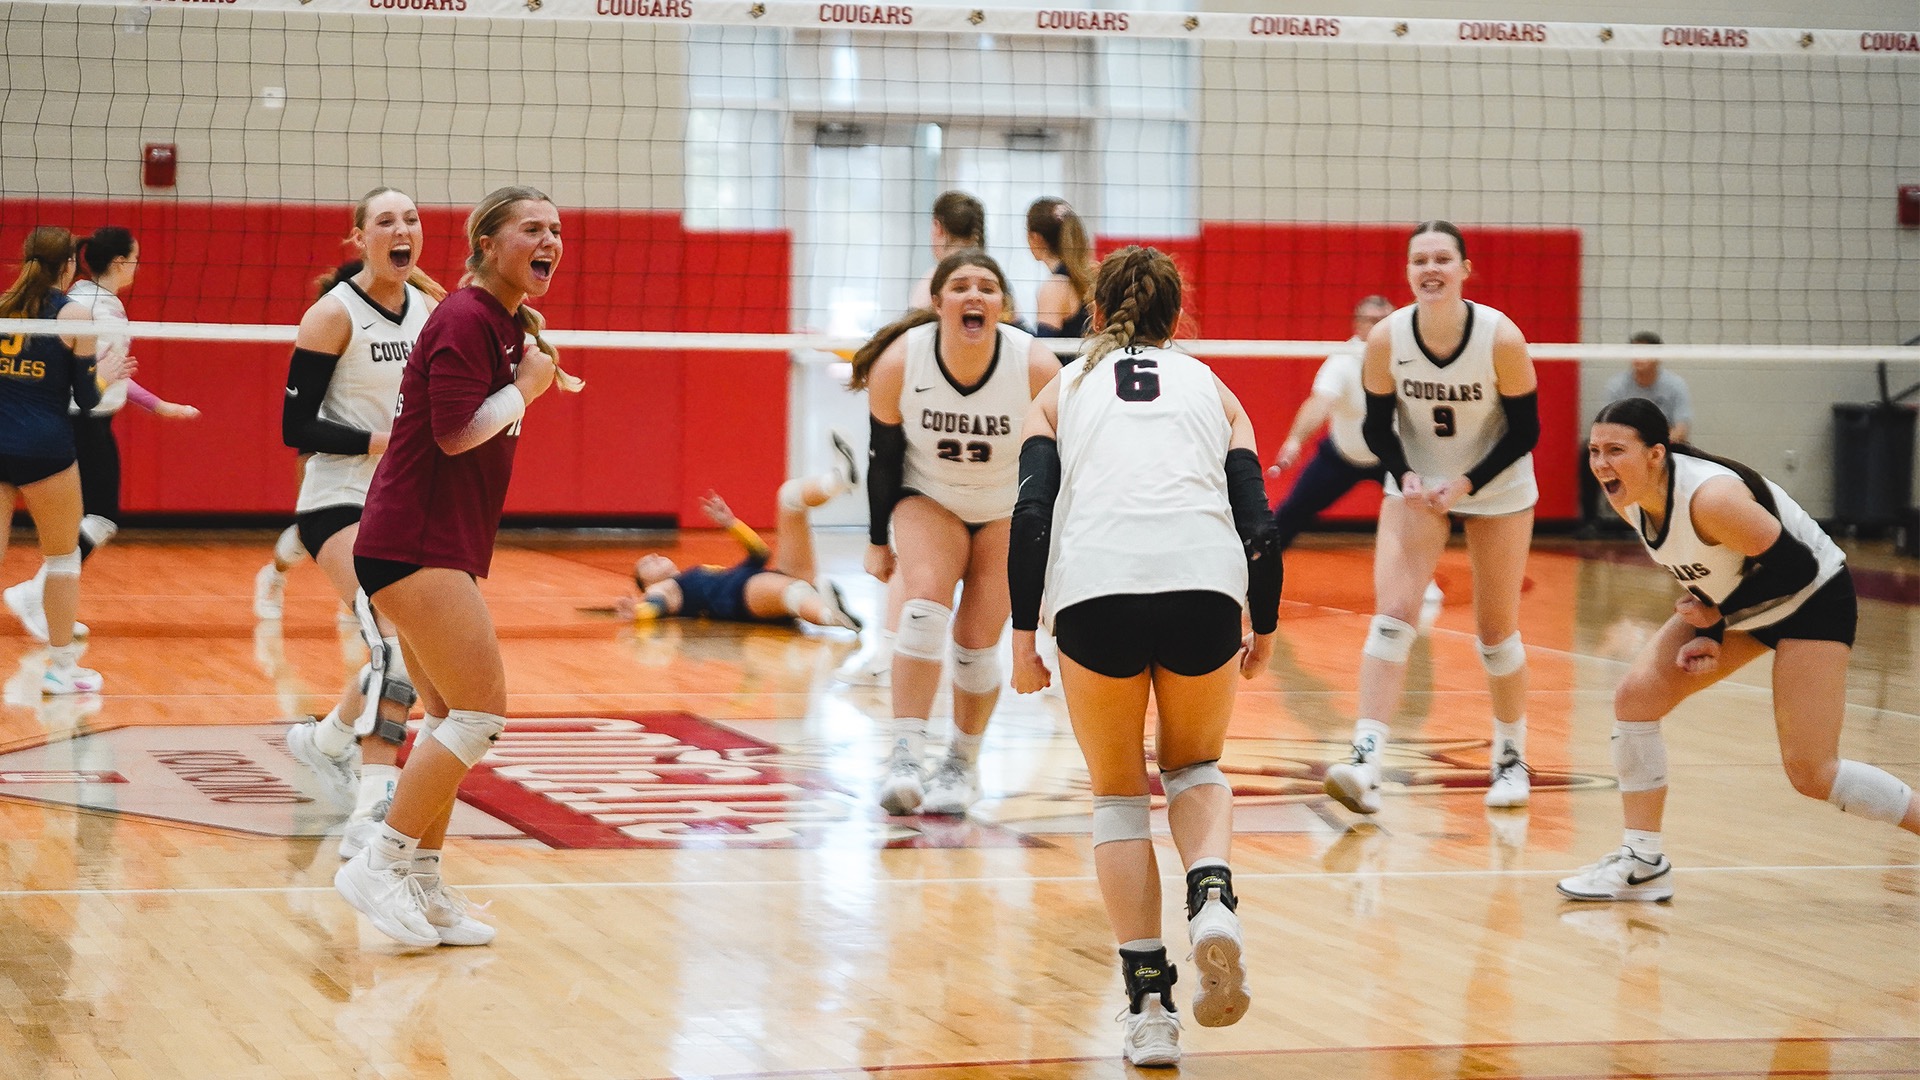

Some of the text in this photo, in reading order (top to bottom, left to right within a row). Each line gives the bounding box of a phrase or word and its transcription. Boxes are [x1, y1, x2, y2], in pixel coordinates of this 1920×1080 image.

[597, 0, 692, 18] COUGARS
[819, 3, 913, 24] COUGARS
[1037, 10, 1130, 31] COUGARS
[1250, 16, 1340, 36] COUGARS
[1459, 22, 1546, 41] COUGARS
[1662, 27, 1749, 48] COUGARS
[1860, 31, 1920, 51] COUGA
[1114, 357, 1161, 402] 6
[1402, 378, 1483, 402] COUGARS
[921, 407, 1012, 436] COUGARS
[1432, 405, 1457, 437] 9
[937, 439, 993, 463] 23
[1663, 562, 1711, 580] ARS
